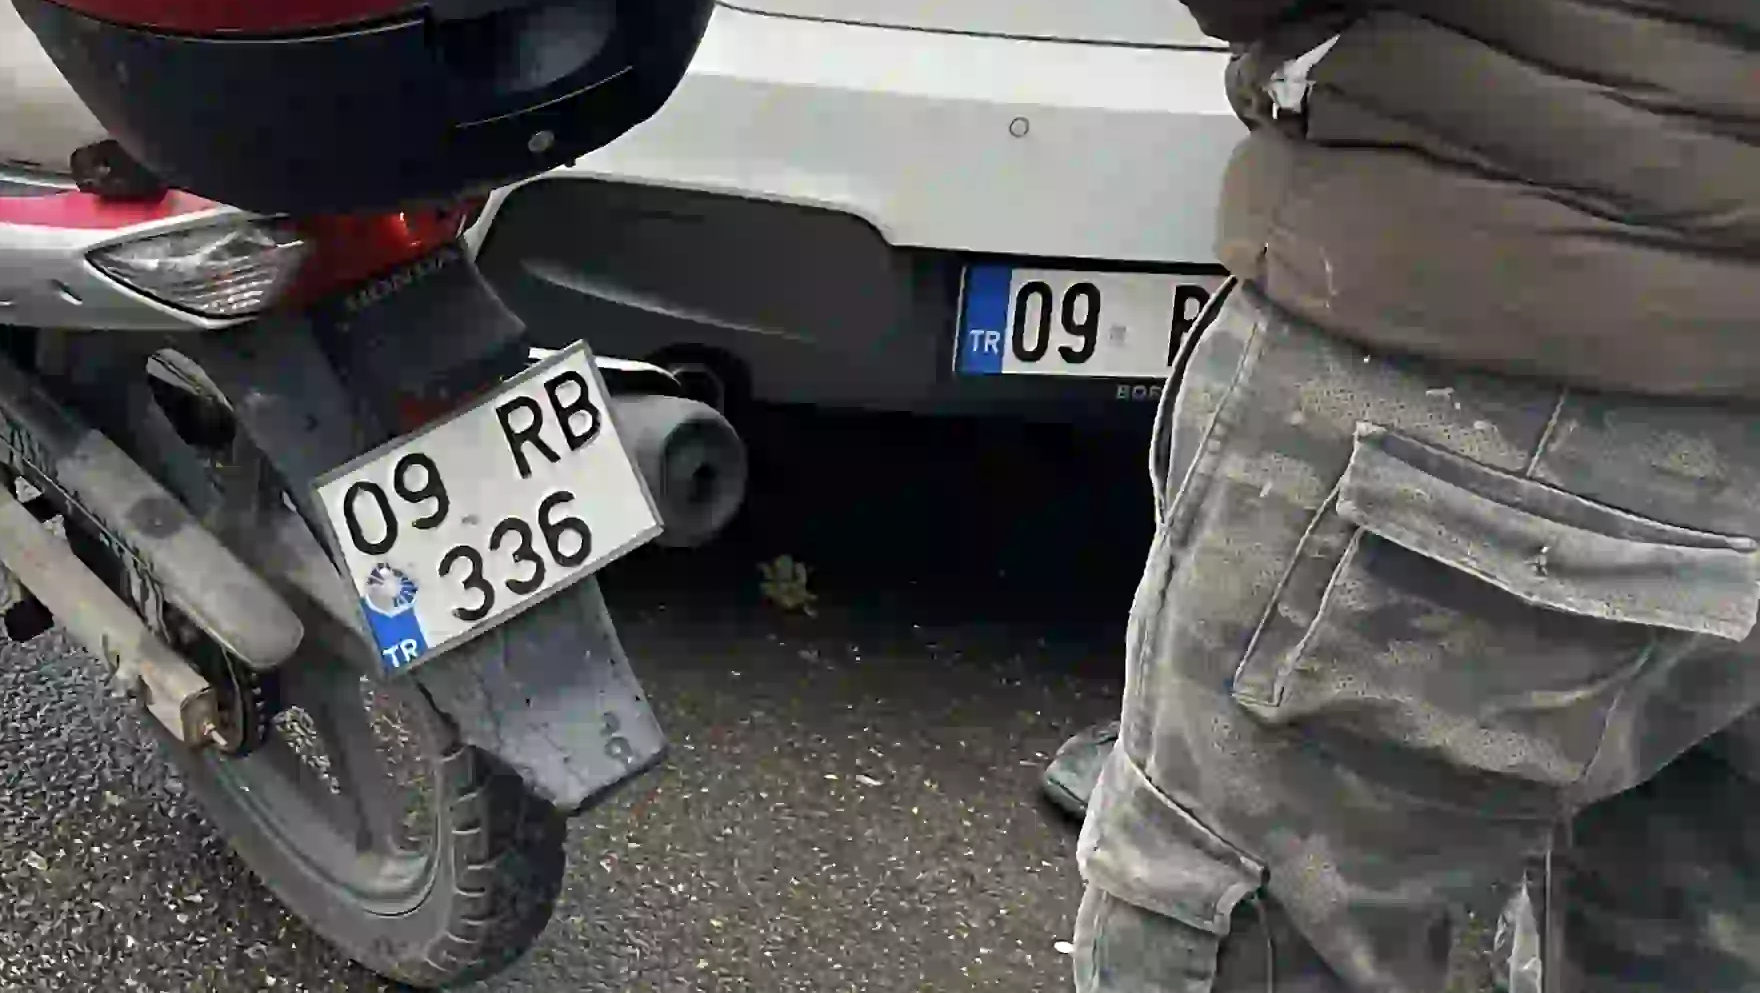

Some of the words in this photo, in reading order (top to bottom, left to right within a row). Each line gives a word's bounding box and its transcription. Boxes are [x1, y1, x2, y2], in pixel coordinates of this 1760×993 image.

[969, 328, 1001, 355] TR
[1012, 281, 1101, 364] 09
[343, 452, 451, 556] 09
[496, 370, 602, 479] RB
[438, 490, 594, 622] 336
[383, 638, 419, 668] TR
